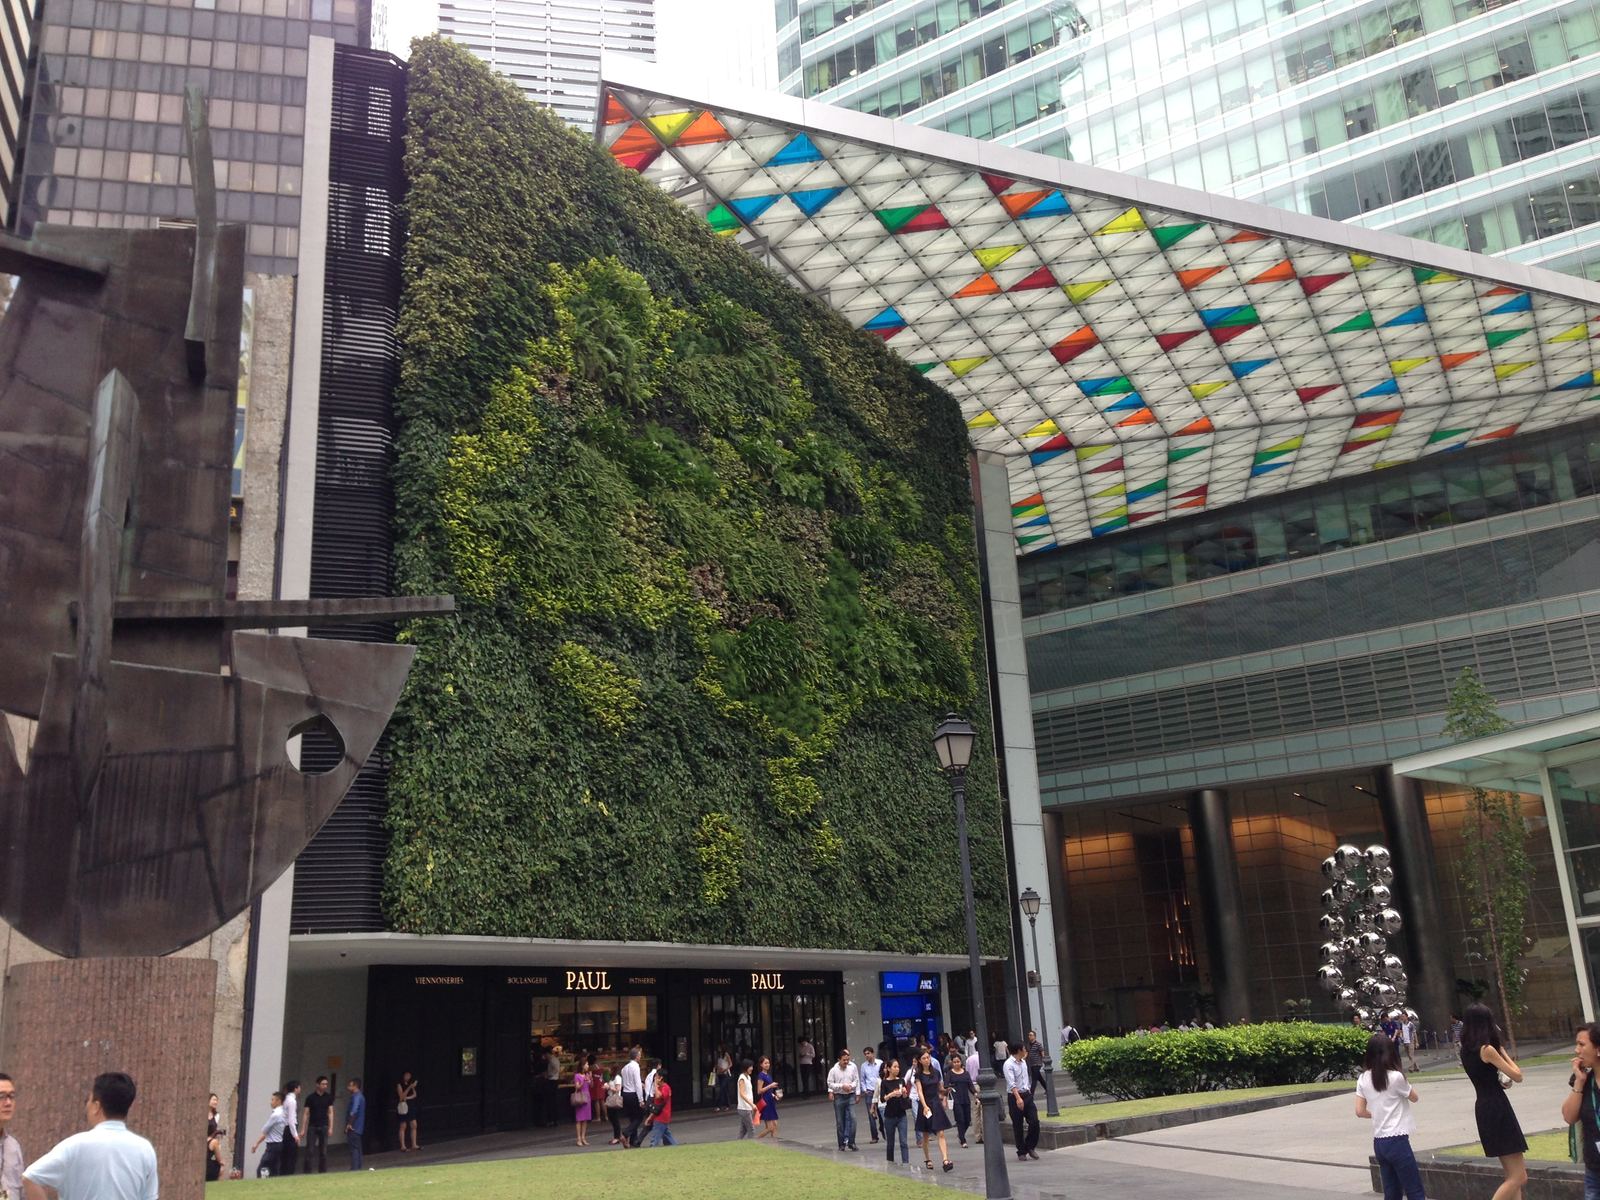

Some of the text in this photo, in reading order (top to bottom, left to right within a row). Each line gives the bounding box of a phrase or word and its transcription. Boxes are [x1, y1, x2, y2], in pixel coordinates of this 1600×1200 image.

[415, 976, 464, 985] VIENNOISERIES
[565, 971, 612, 990] PAUL
[751, 973, 785, 990] PAUL
